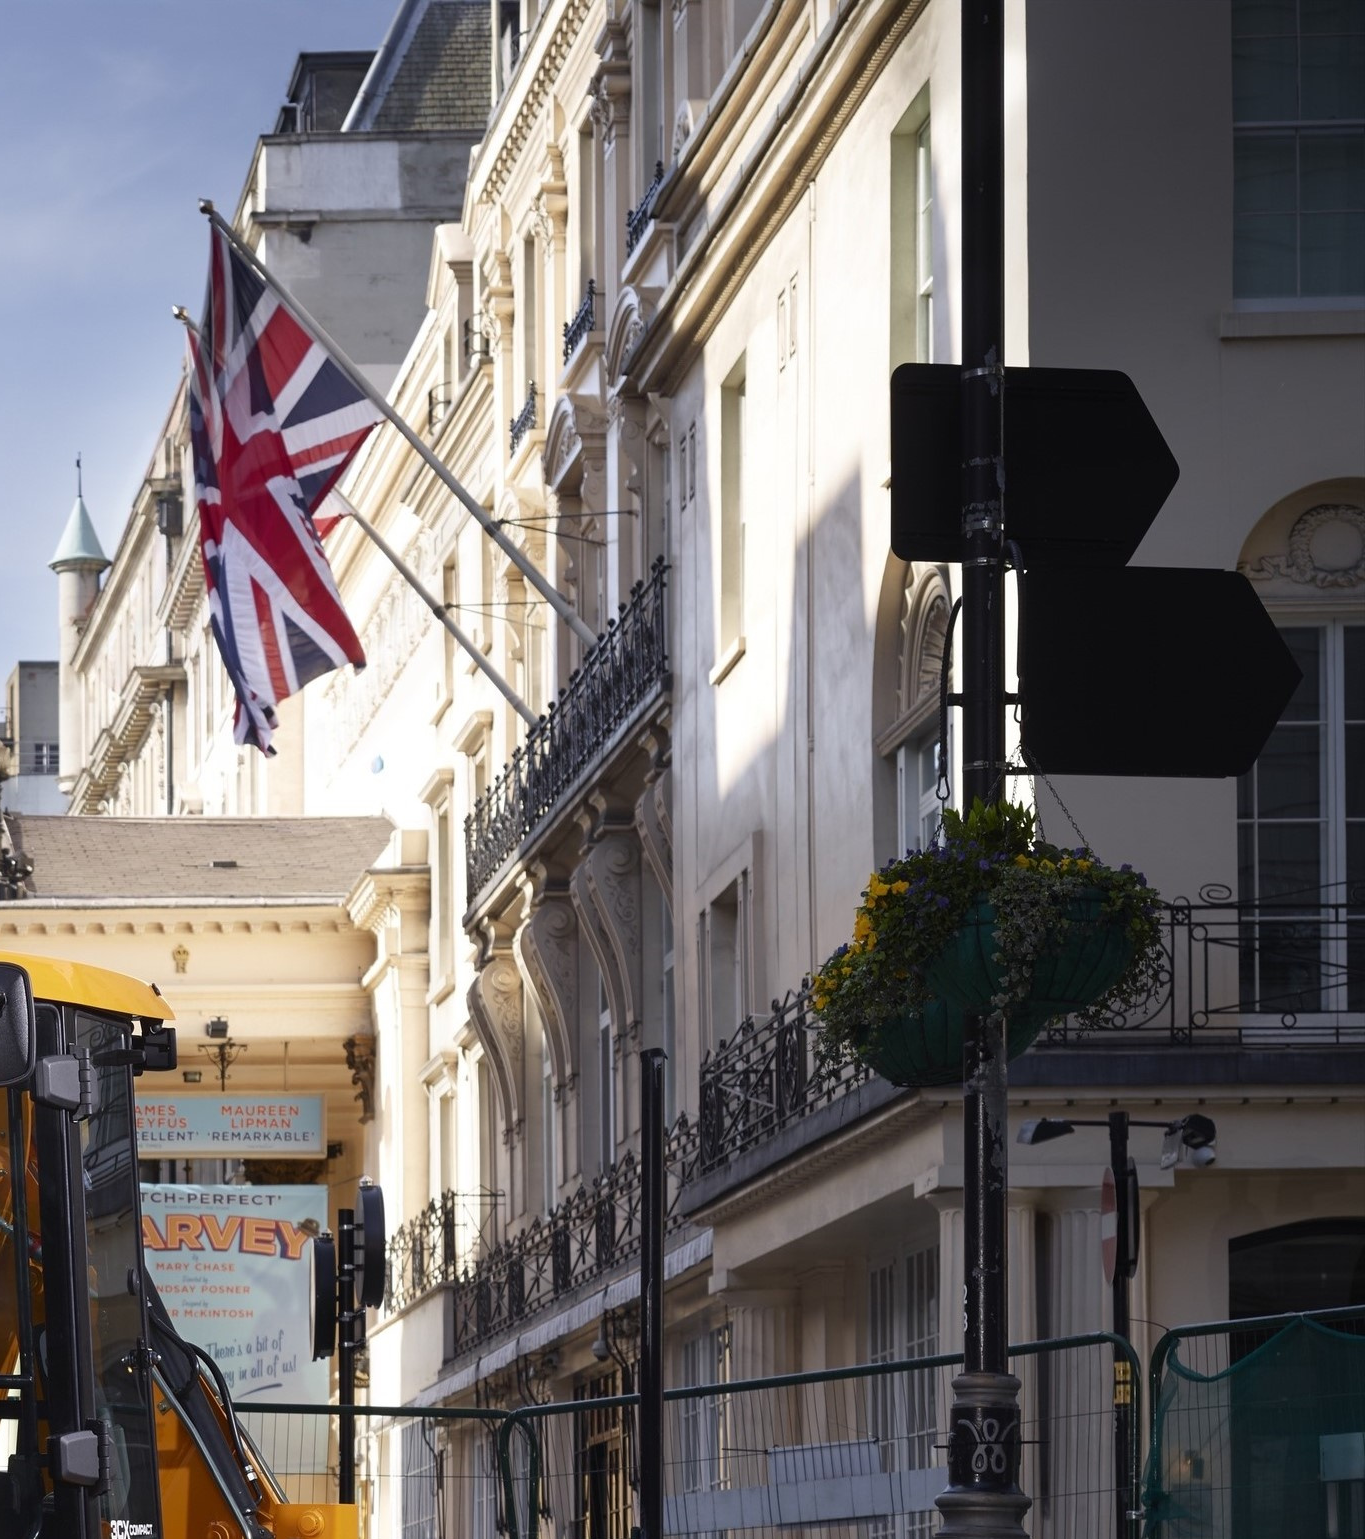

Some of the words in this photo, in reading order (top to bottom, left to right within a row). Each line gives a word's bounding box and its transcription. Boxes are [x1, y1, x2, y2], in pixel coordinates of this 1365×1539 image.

[135, 1105, 176, 1116] AMES
[221, 1105, 300, 1116] MAUREEN
[137, 1118, 187, 1129] EYFUS
[231, 1118, 292, 1129] LIPMAN
[207, 1131, 315, 1142] 'REMARKABLE'
[141, 1192, 282, 1206] TCH-PERFECT'
[142, 1213, 312, 1261] ARVEY
[156, 1263, 189, 1272] MARY
[195, 1263, 235, 1272] CHASE
[156, 1285, 195, 1294] NDSAY
[201, 1285, 250, 1294] POSNER
[184, 1309, 253, 1318] McKINTOSH
[206, 1339, 242, 1359] There's
[247, 1345, 252, 1354] a
[256, 1335, 268, 1353] bit
[272, 1329, 284, 1352] of
[239, 1366, 247, 1380] in
[251, 1360, 263, 1379] all
[266, 1356, 279, 1378] of
[129, 1523, 153, 1536] COMPACT
